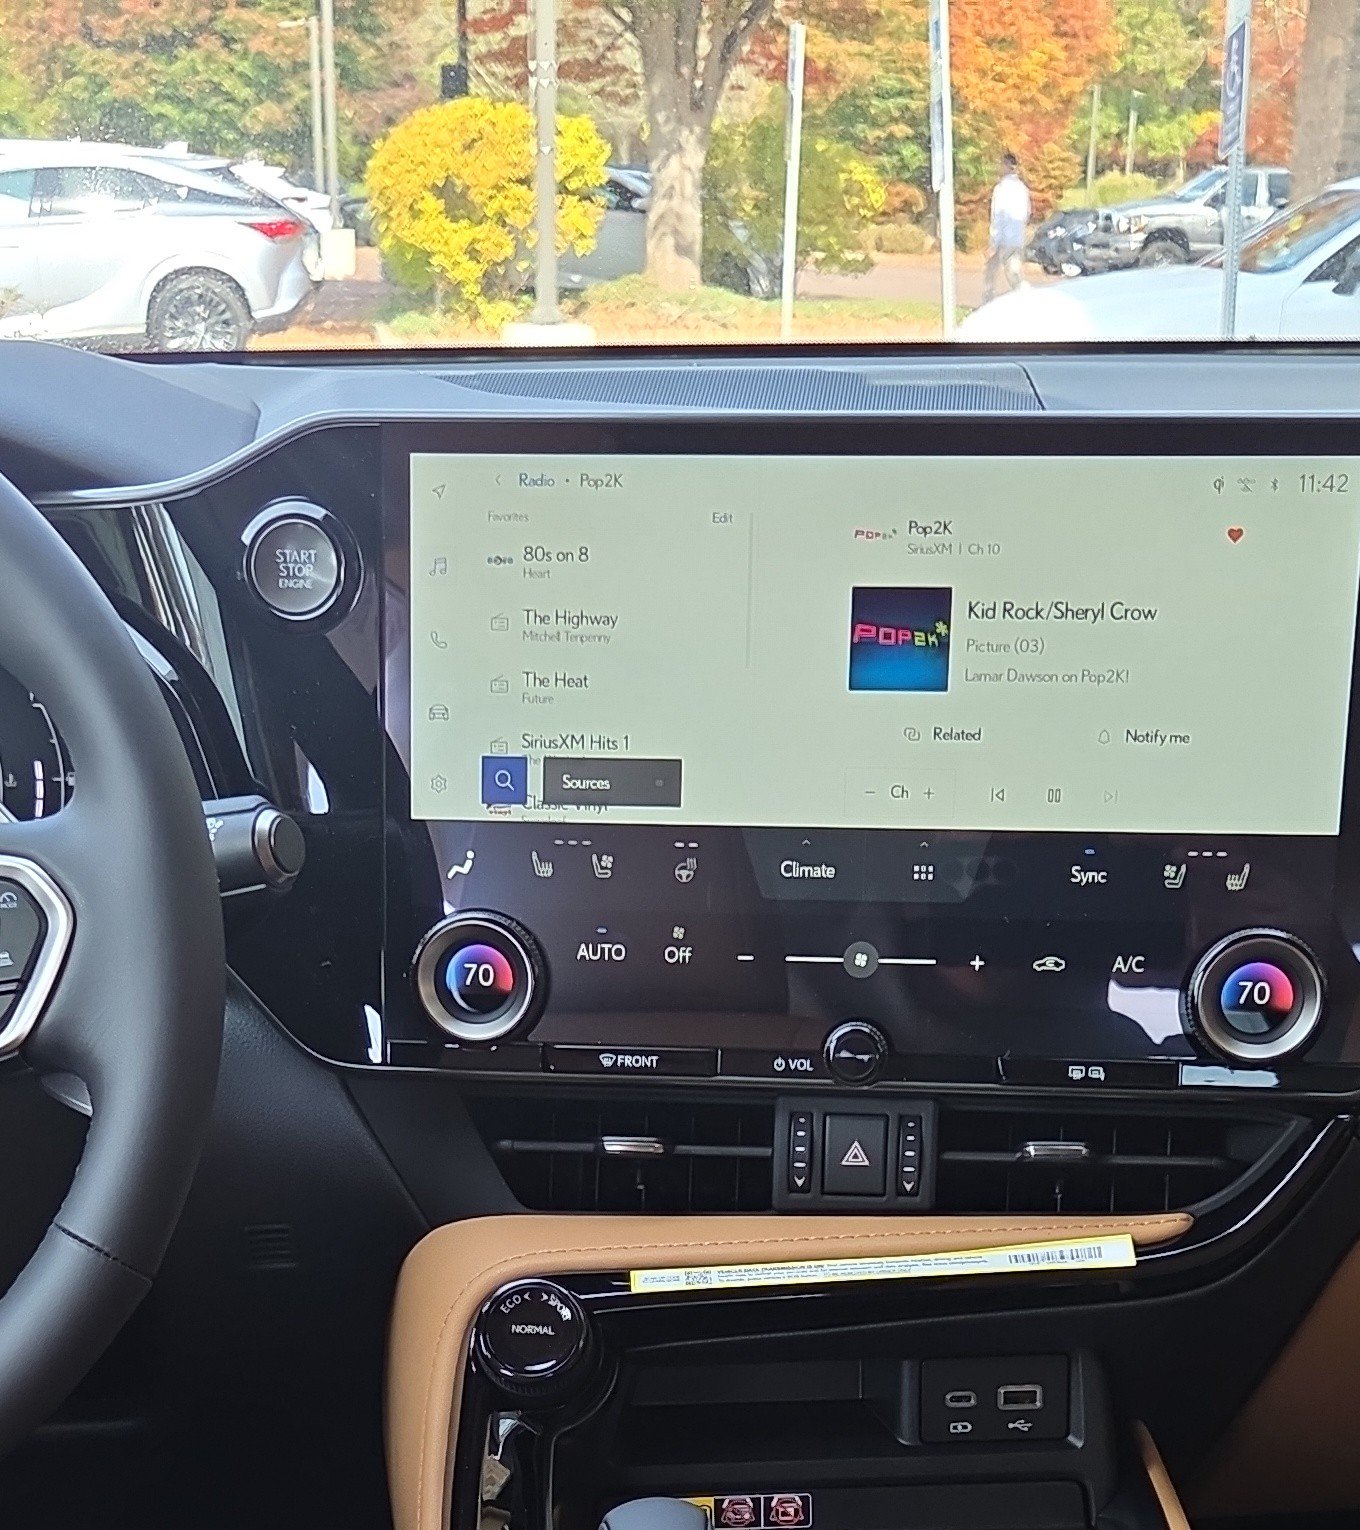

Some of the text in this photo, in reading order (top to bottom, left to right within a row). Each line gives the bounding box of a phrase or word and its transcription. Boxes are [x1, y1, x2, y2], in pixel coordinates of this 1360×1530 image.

[518, 473, 624, 490] Radio Pop2K
[1299, 473, 1349, 493] 11:42
[487, 511, 529, 523] Favorites
[711, 511, 734, 524] Edit
[908, 519, 953, 538] Pop2K
[275, 549, 317, 563] START
[523, 545, 552, 562] 80s
[556, 550, 574, 562] on
[578, 545, 589, 562] 8
[907, 543, 1000, 555] SiriusXM Ch 10
[278, 564, 314, 577] STOP
[523, 567, 551, 579] Heart
[278, 579, 313, 589] ENGINE
[522, 609, 618, 629] The Highway
[967, 601, 1158, 624] Kid Rock/Sheryl Crow
[966, 637, 1045, 655] Picture (03)
[522, 671, 589, 688] The Heat
[965, 668, 1130, 686] Lamar Dawson on Pop2K!
[521, 692, 554, 705] Future
[521, 733, 630, 750] SiriusXM Hits 1
[933, 727, 982, 742] Related
[1125, 729, 1191, 746] Notify me
[562, 774, 611, 790] Sources
[890, 785, 909, 799] Ch
[780, 859, 836, 881] Climate
[1070, 865, 1108, 888] Sync
[576, 943, 626, 961] AUTO
[664, 946, 693, 964] Off
[1111, 955, 1145, 974] A/C
[463, 963, 495, 988] 70
[1238, 980, 1271, 1006] 70
[617, 1055, 659, 1069] FRONT
[788, 1057, 814, 1072] VOL
[500, 1294, 522, 1314] ECO
[548, 1293, 572, 1321] SPORT
[511, 1324, 556, 1336] NORMAL
